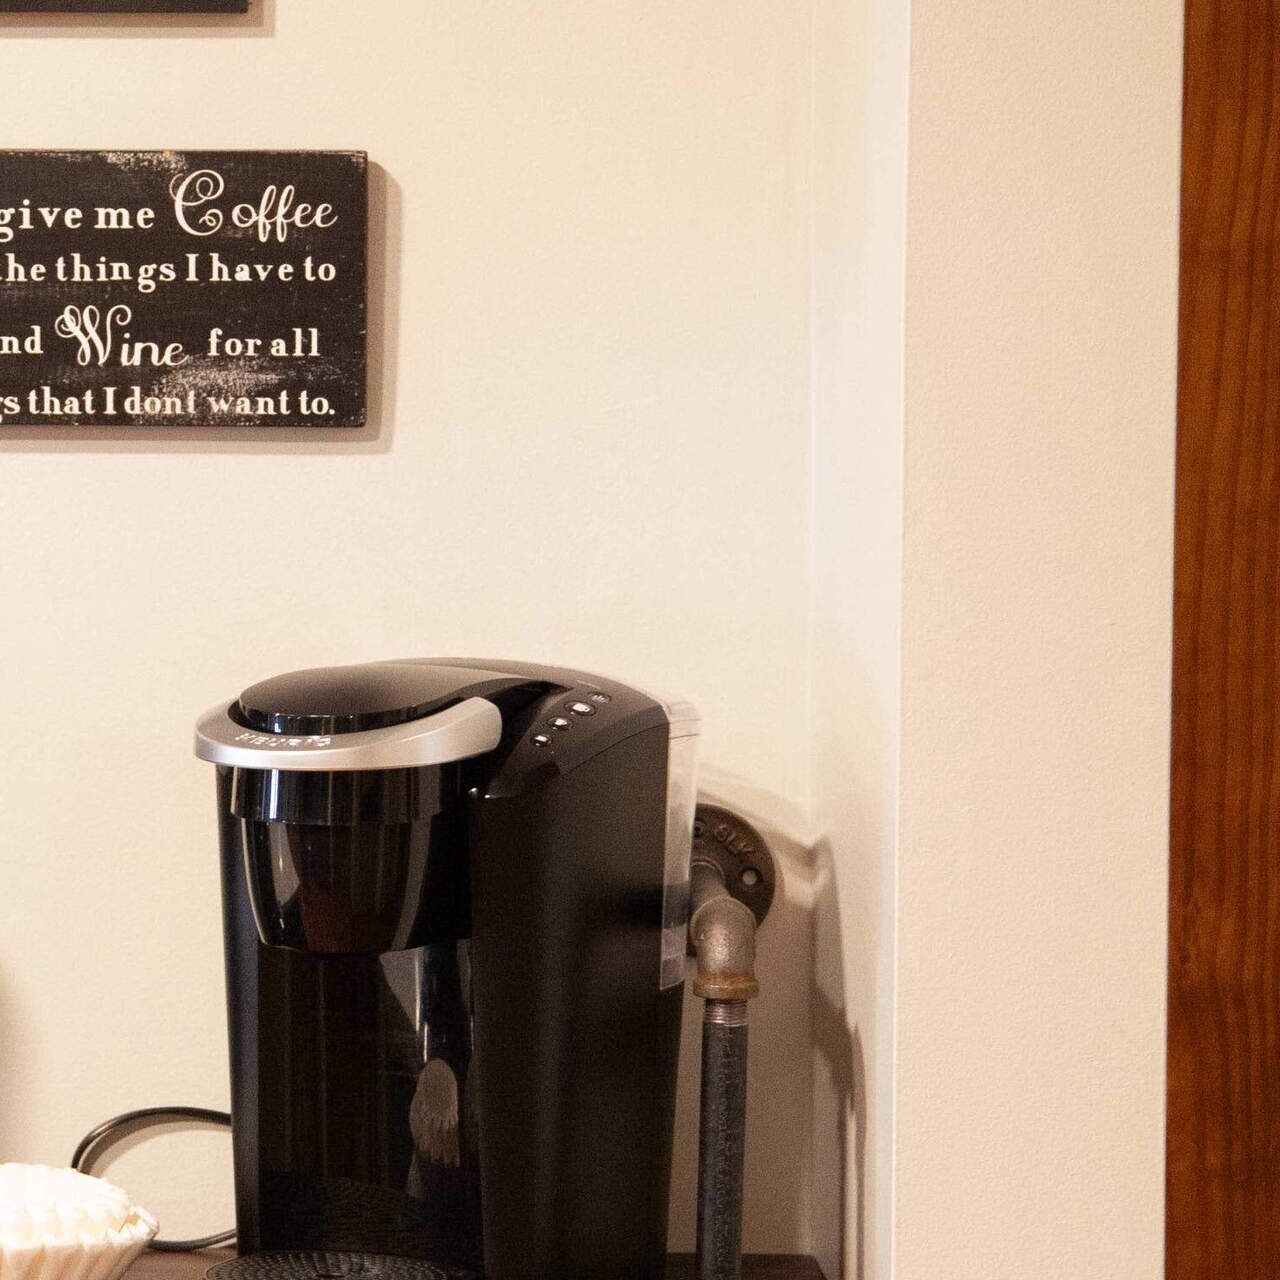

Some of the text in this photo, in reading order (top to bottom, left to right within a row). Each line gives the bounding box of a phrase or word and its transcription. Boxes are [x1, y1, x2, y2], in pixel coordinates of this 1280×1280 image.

[94, 205, 156, 230] me
[169, 168, 339, 243] Coffee
[55, 252, 177, 293] things
[185, 253, 200, 282] I
[209, 252, 293, 283] have
[303, 256, 337, 282] to
[53, 303, 190, 368] Wine
[206, 327, 263, 358] for
[270, 327, 321, 357] all
[26, 386, 97, 416] that
[102, 386, 118, 416] I
[209, 389, 293, 416] want
[298, 389, 336, 416] to.
